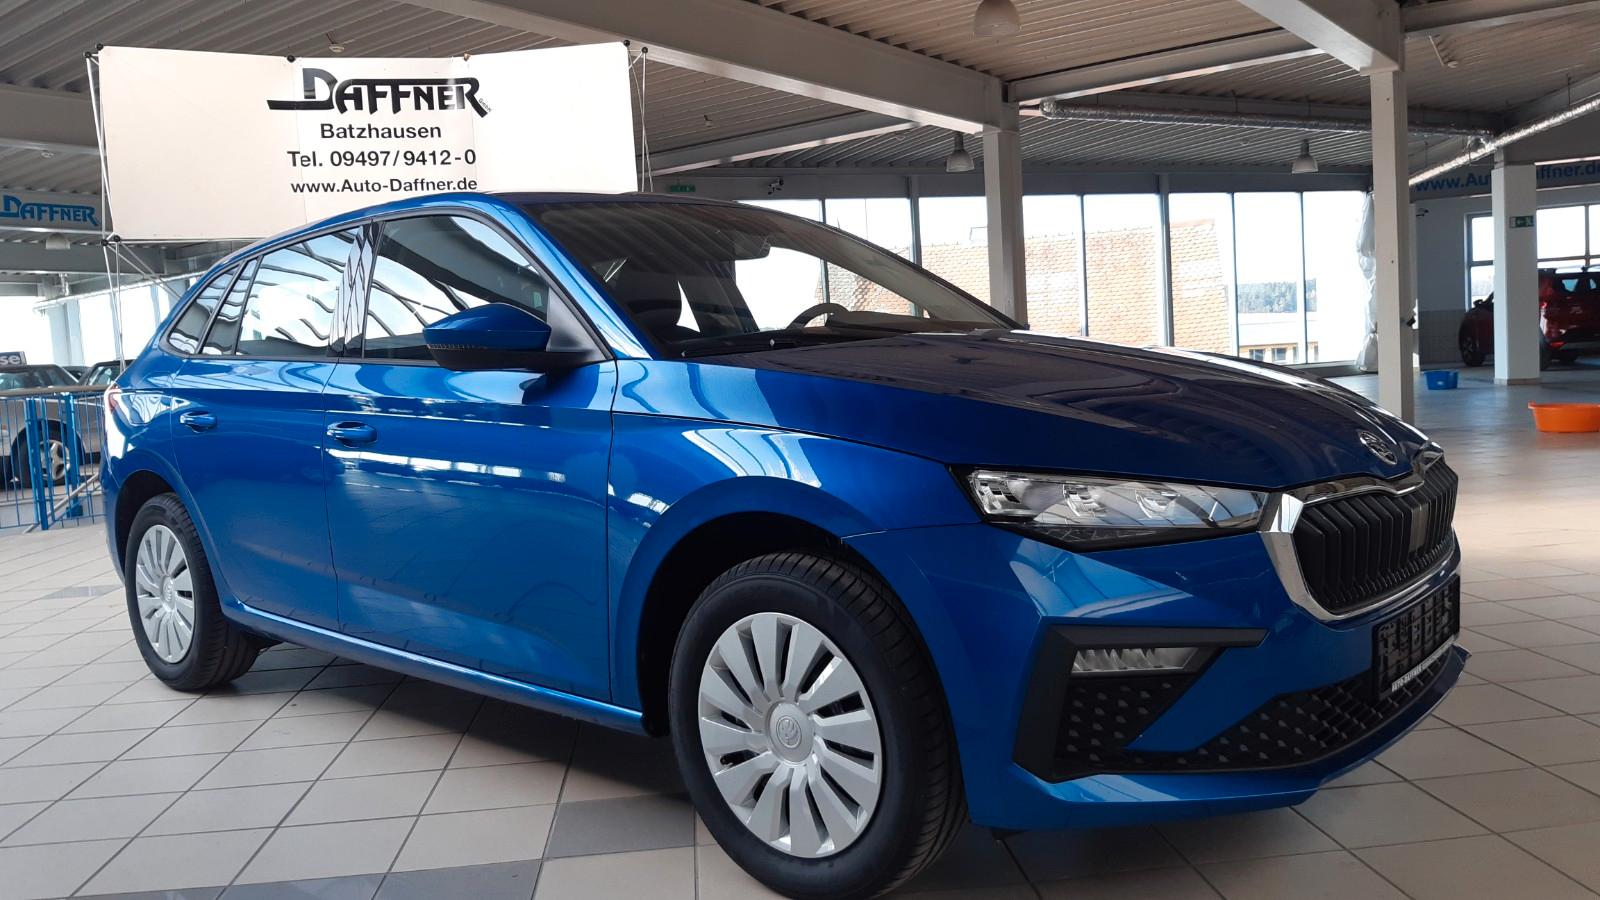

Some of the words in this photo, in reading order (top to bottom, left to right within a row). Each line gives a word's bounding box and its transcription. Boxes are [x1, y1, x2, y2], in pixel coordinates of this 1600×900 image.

[267, 68, 488, 118] DAFFNER
[321, 123, 442, 139] Batzhausen
[287, 151, 323, 167] Tel.
[290, 177, 478, 193] www.Auto-Daffner.de
[0, 195, 98, 226] DAFFNER
